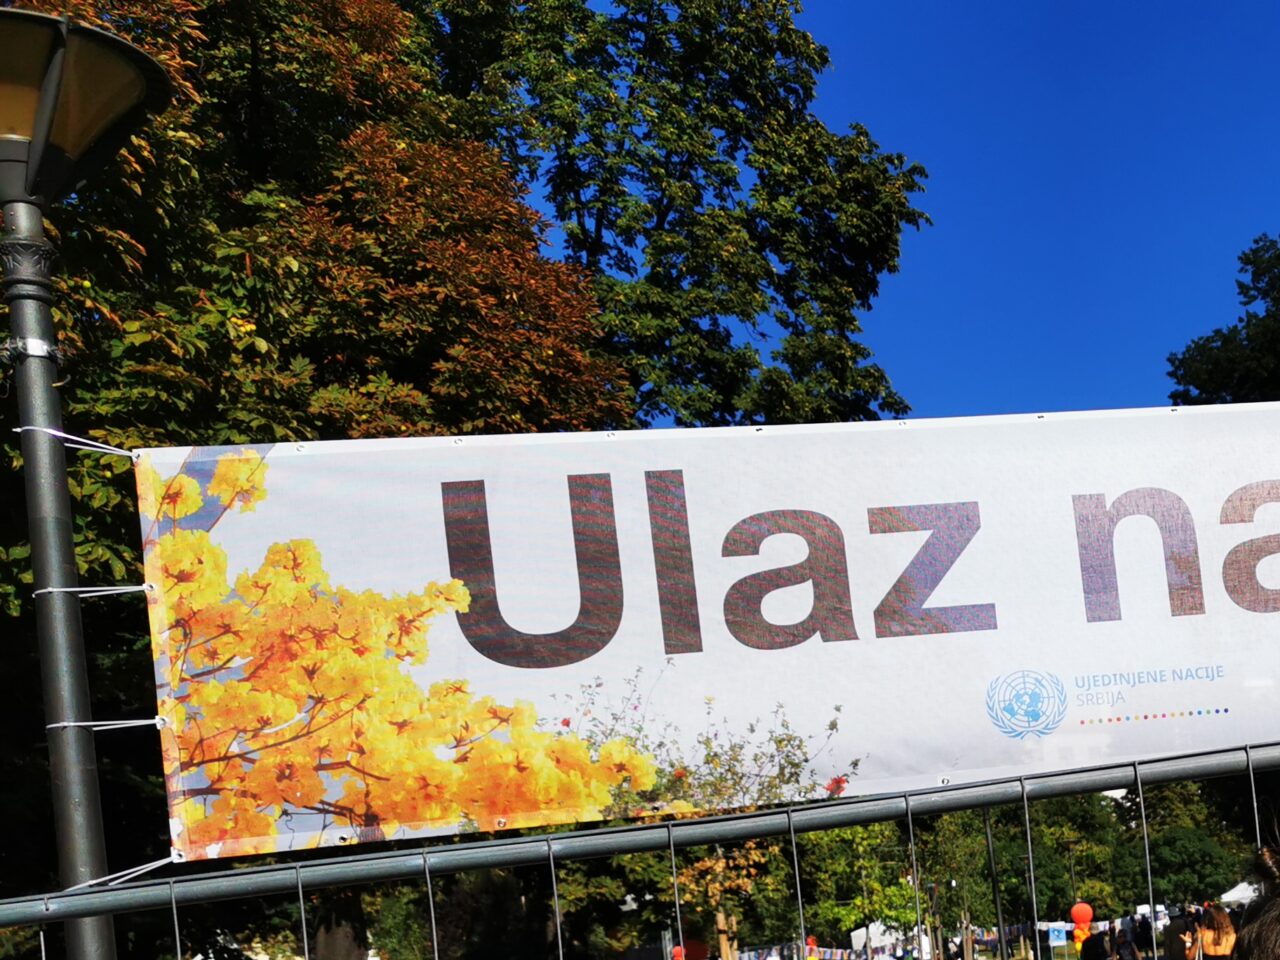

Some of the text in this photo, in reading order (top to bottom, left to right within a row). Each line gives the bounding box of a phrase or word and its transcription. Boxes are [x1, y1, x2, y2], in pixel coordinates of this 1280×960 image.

[441, 469, 998, 669] Ulaz
[1074, 664, 1225, 691] UJEDINJENE NACIJE
[1075, 690, 1127, 707] SRBIJA
